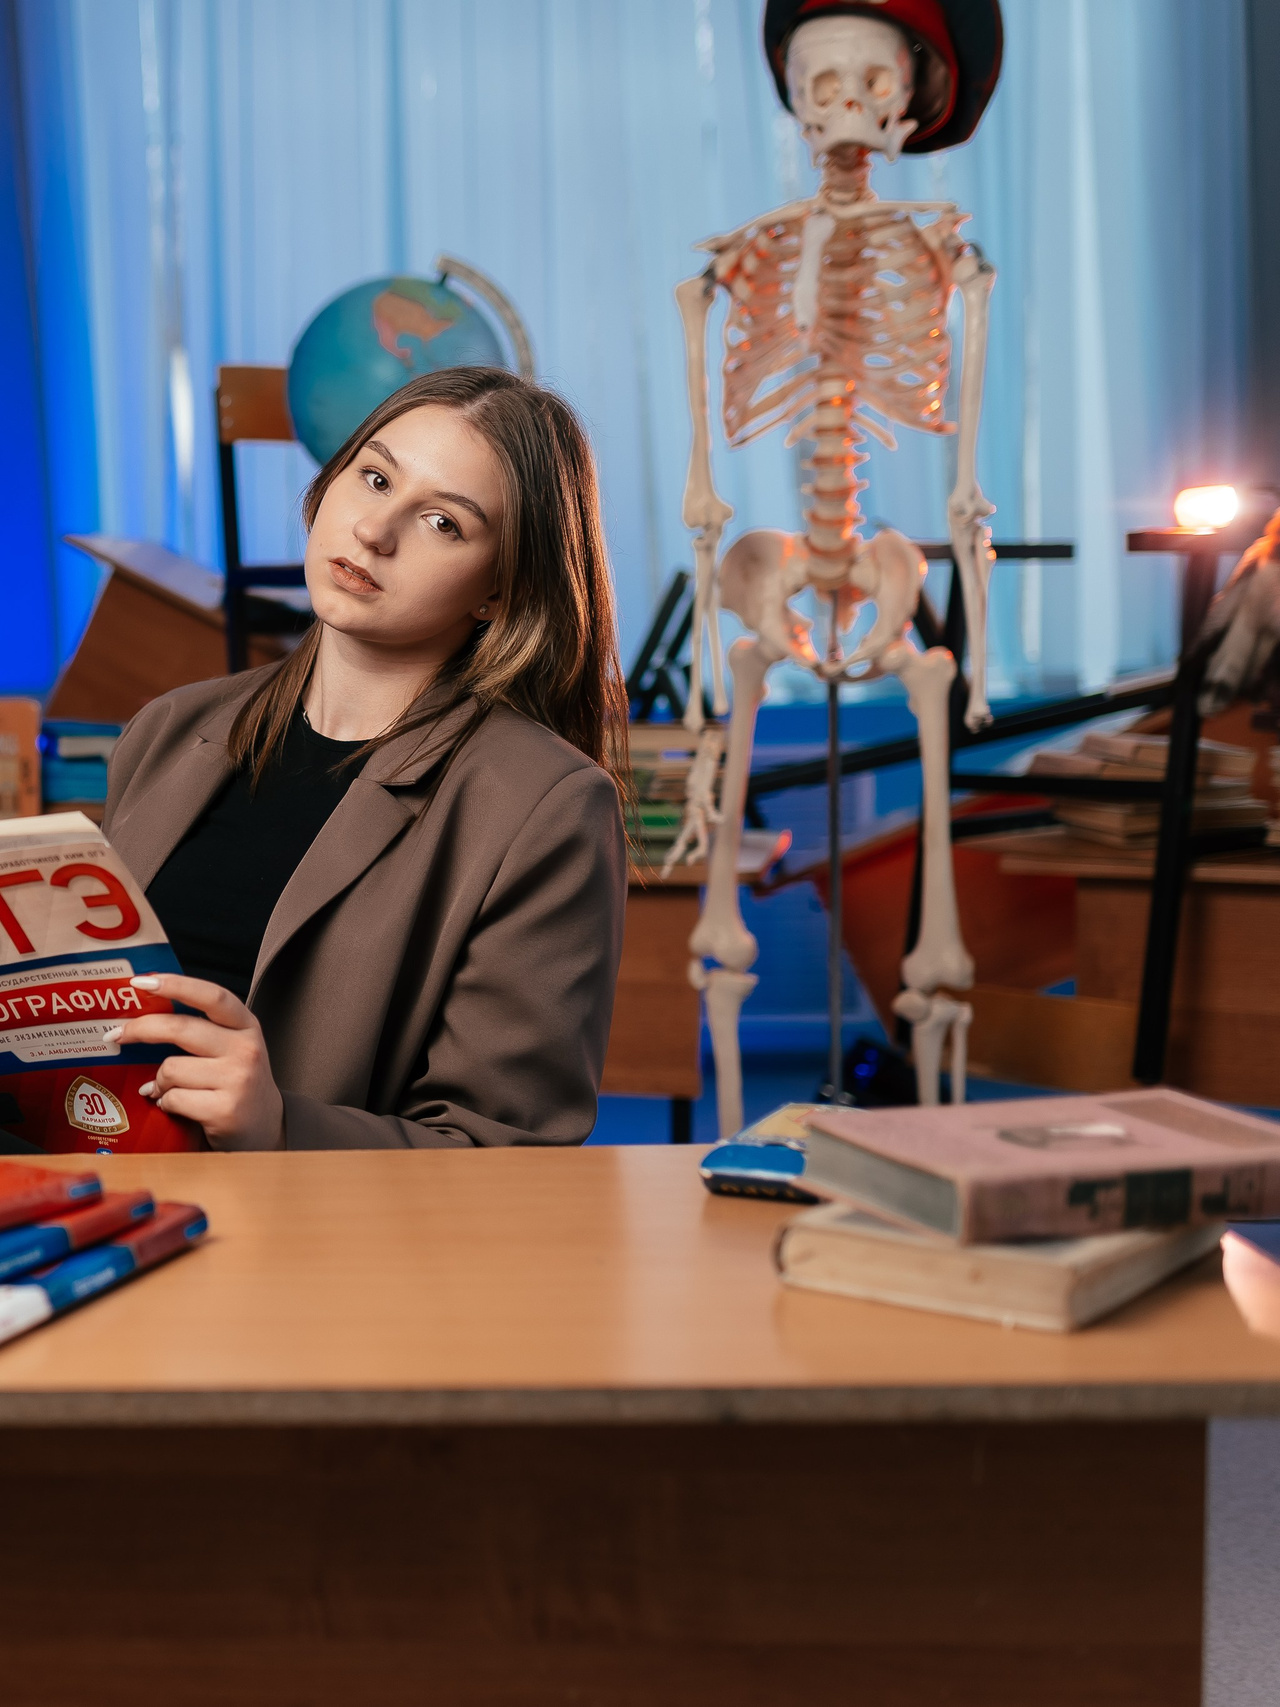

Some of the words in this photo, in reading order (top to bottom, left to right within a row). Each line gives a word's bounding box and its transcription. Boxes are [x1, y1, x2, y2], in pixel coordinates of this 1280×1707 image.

[63, 852, 85, 861] КИМ
[82, 966, 124, 977] ЭКЗАМЕН
[15, 1024, 99, 1042] ЭКЗАМЕНАЦИОННЫЕ
[48, 1045, 107, 1055] АМБАРЦУМОВОЙ
[67, 1086, 77, 1112] НОВАЯ
[78, 1093, 106, 1115] 30
[81, 1116, 115, 1124] ВАРИАНТОВ
[82, 1123, 100, 1131] КИМ
